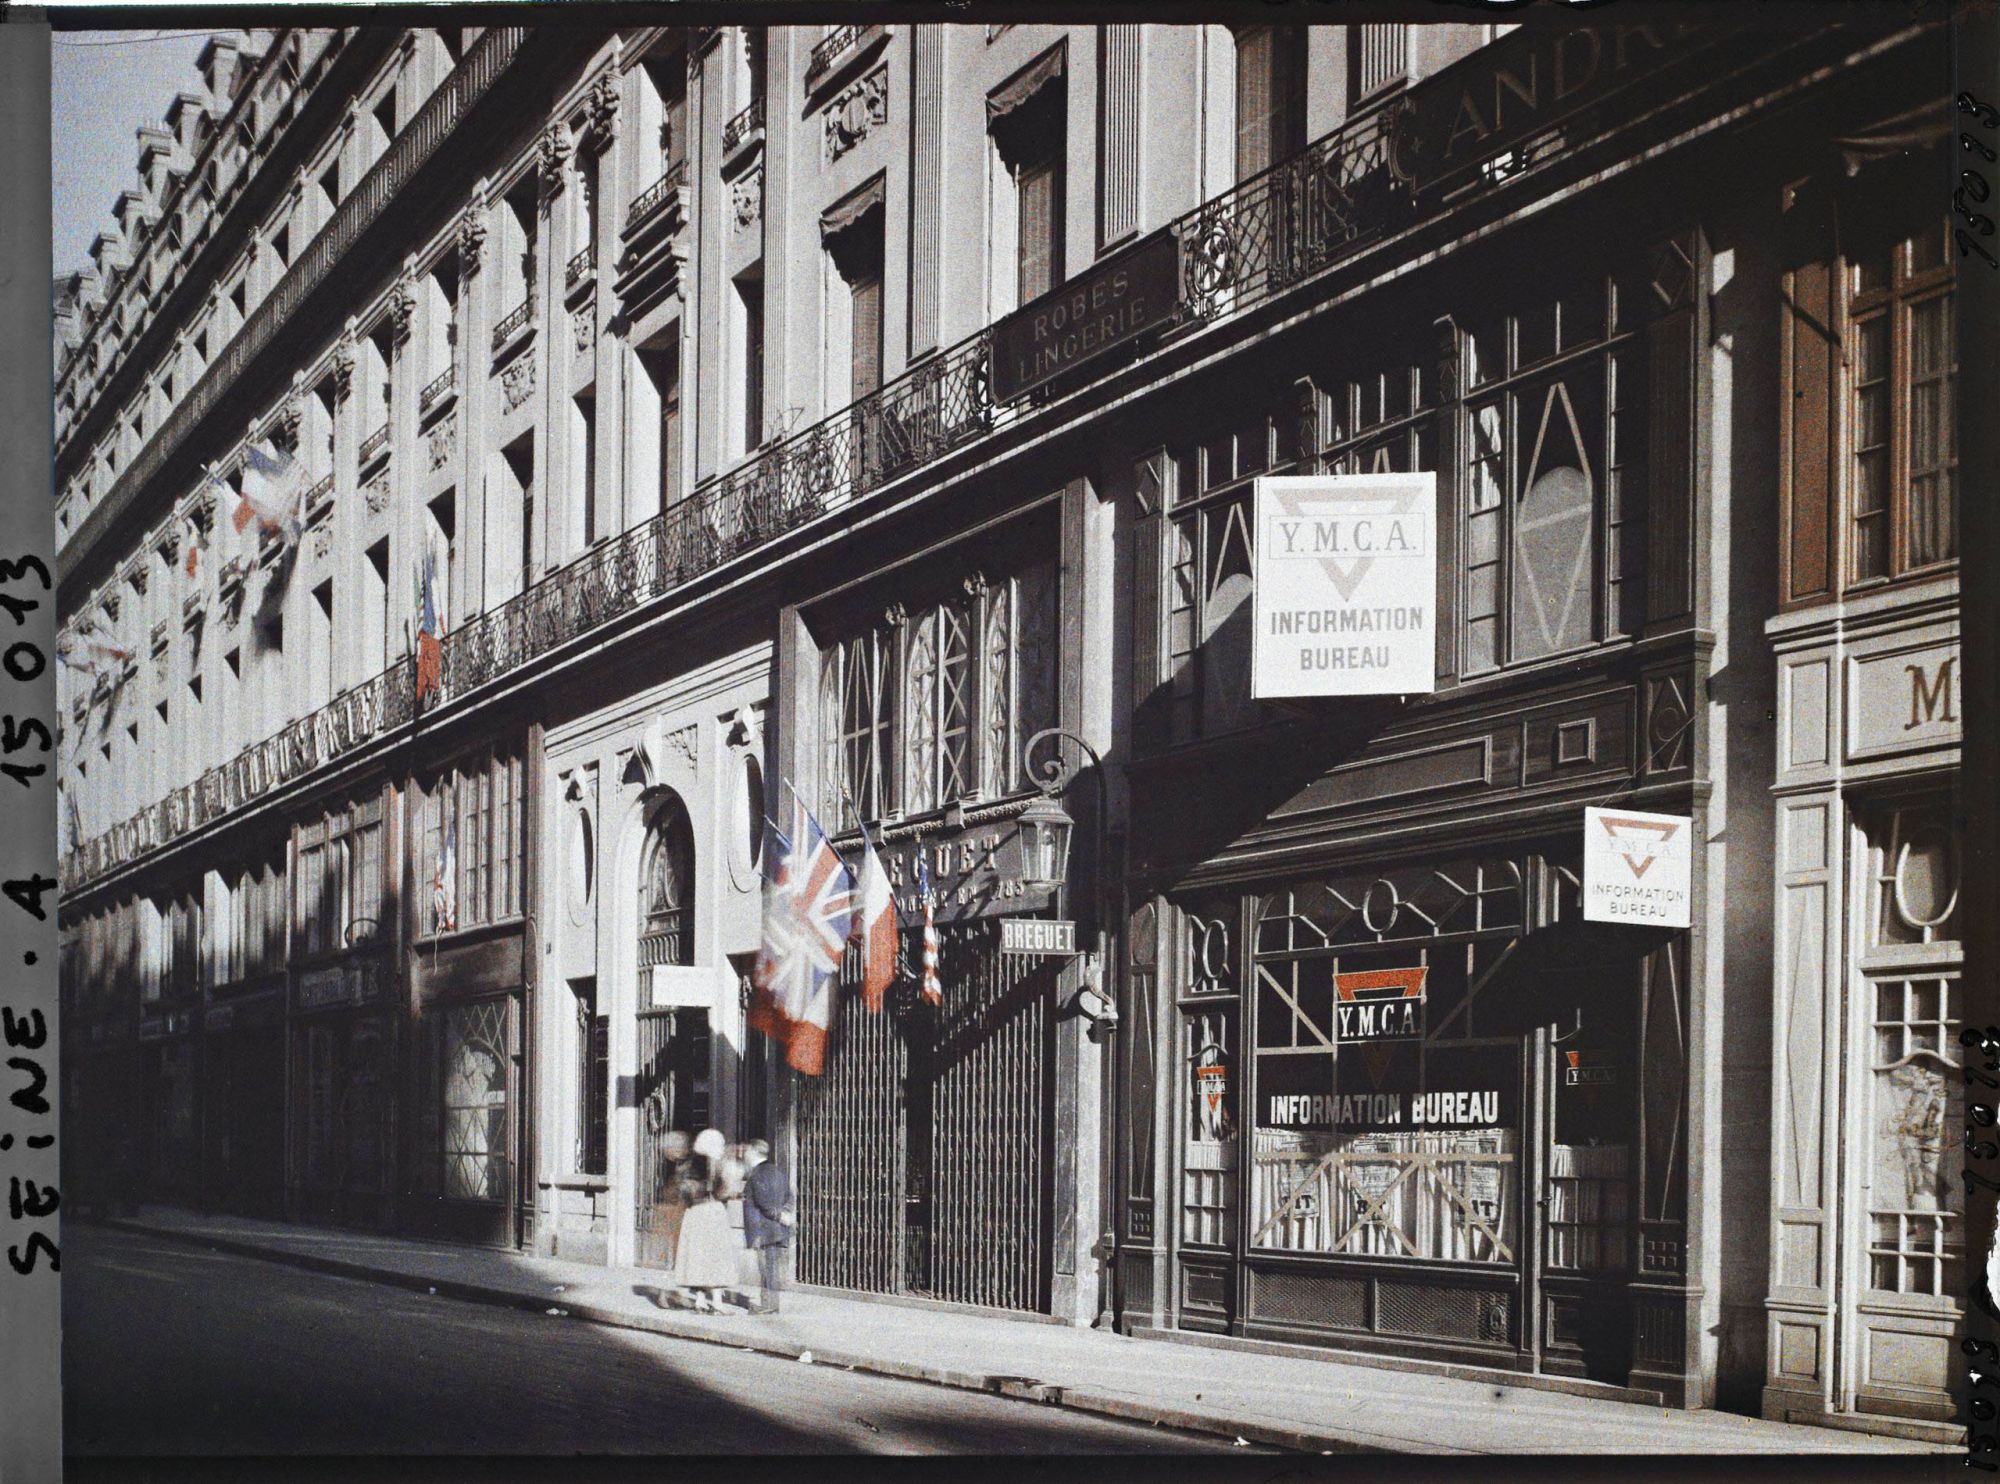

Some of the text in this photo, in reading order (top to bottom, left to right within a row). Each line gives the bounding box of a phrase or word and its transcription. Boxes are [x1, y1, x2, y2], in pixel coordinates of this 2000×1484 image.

[1033, 271, 1129, 342] ROBES
[1019, 297, 1147, 383] LINGERIE
[1279, 519, 1417, 553] Y.M.C.A.
[1271, 607, 1424, 635] INFORMATION
[1300, 646, 1391, 671] BUREAU
[1904, 656, 1959, 731] M
[2, 873, 57, 922] A
[1592, 884, 1684, 901] INFORMATION
[1609, 901, 1667, 918] BUREAU
[1004, 923, 1074, 950] BREGUET
[1338, 1002, 1421, 1038] Y.M.C.A.
[1270, 1090, 1499, 1125] INFORMATION BUREAU
